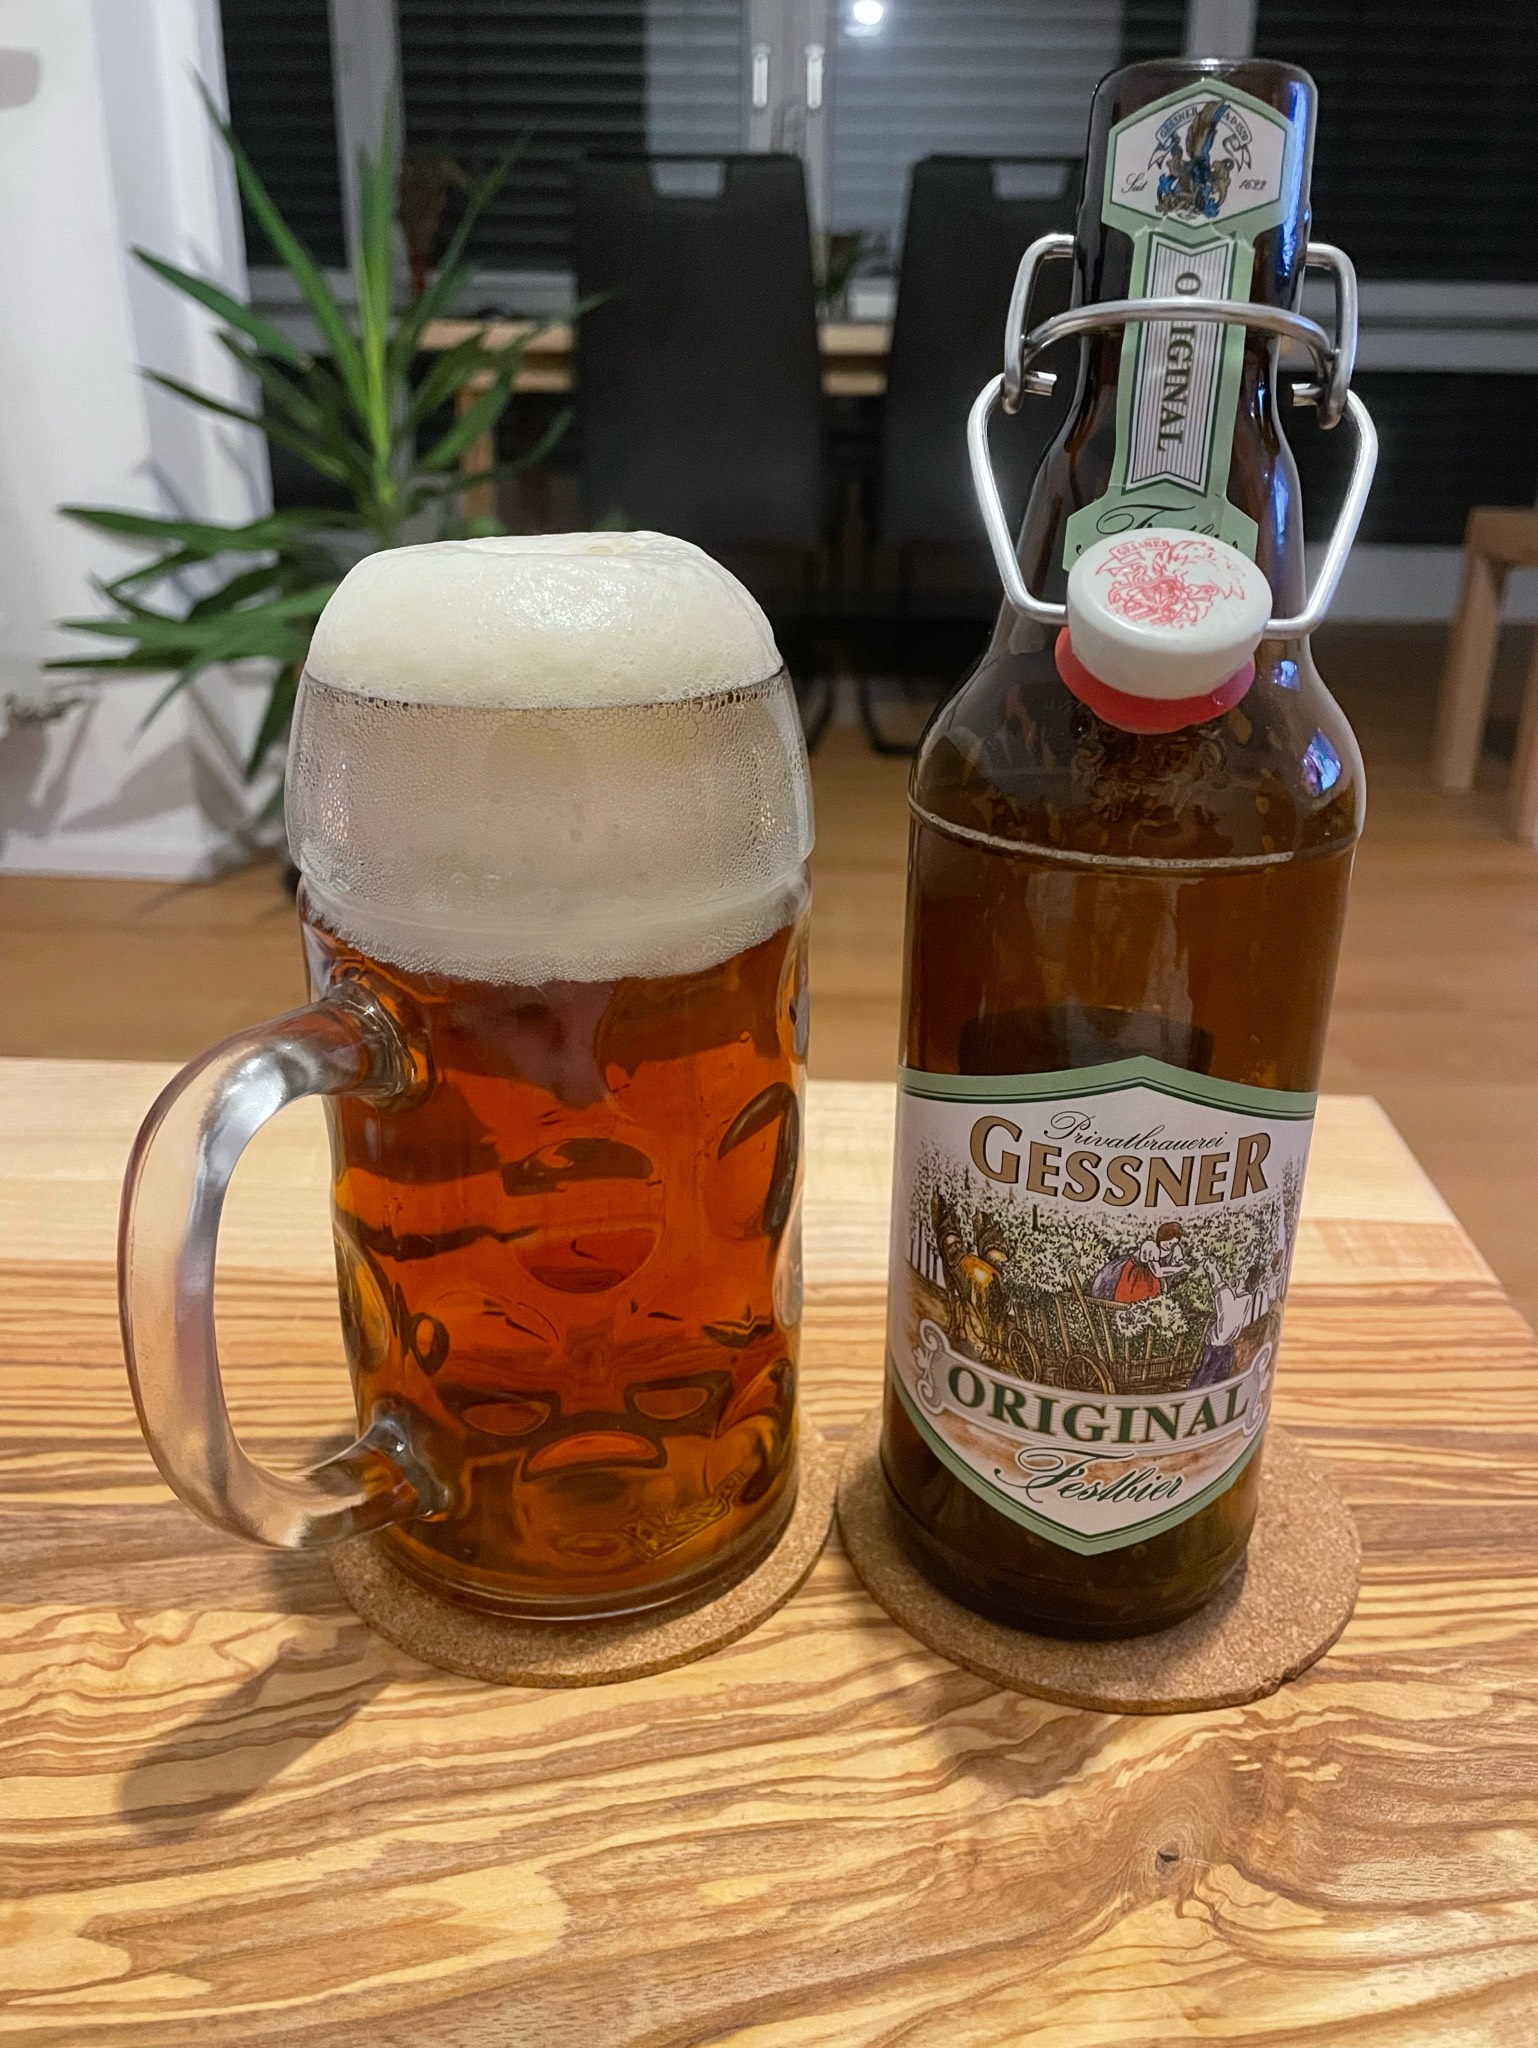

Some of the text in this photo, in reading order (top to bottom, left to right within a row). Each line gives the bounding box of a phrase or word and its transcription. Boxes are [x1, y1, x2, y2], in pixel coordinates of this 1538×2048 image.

[1121, 172, 1148, 195] Seit
[1158, 272, 1202, 453] OIGINAL
[969, 1115, 1272, 1208] GESSNER
[1043, 1110, 1228, 1151] Privatbrauerei
[947, 1366, 1249, 1444] ORIGINAL
[994, 1447, 1183, 1504] Festbier
